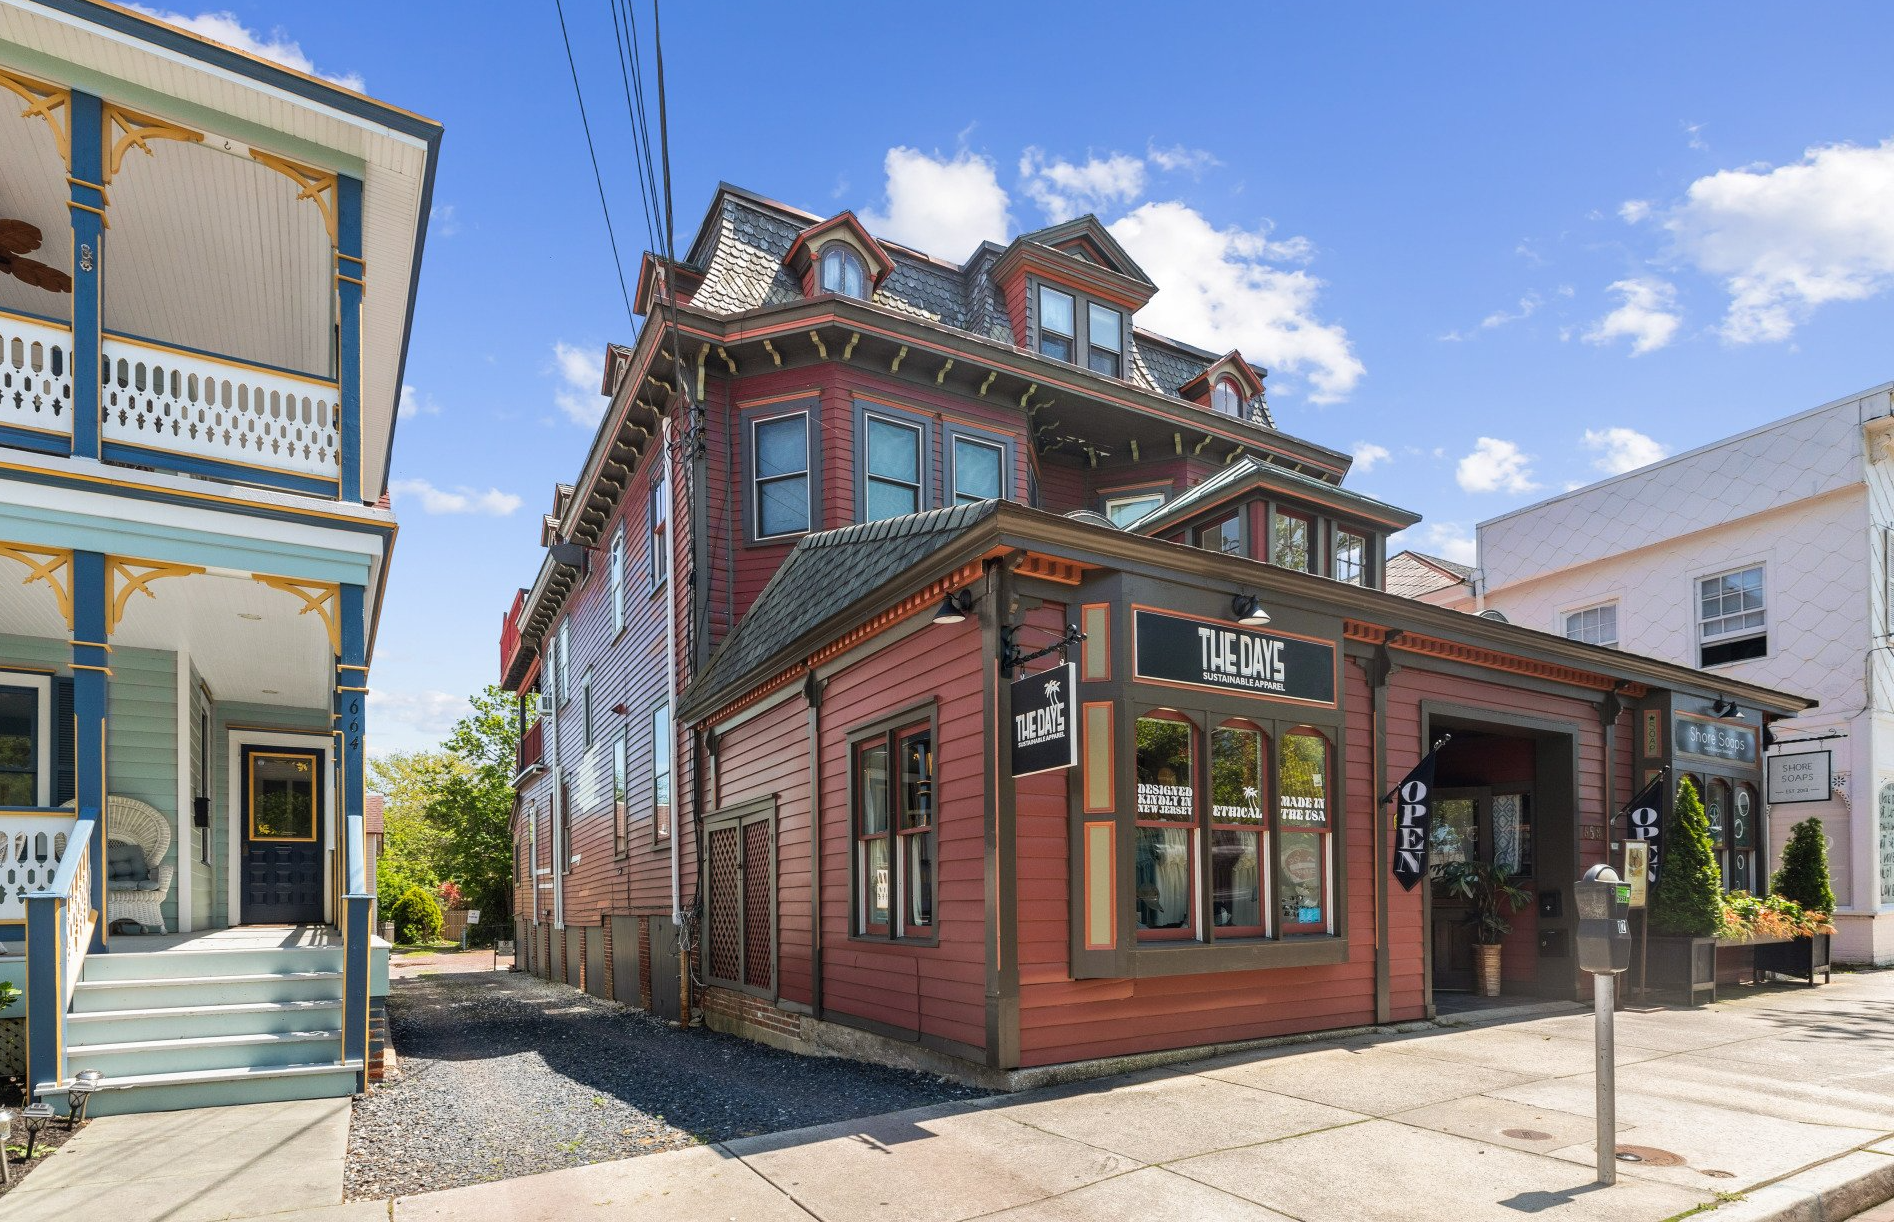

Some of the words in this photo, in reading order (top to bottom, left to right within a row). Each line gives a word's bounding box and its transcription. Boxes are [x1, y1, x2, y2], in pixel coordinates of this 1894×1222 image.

[1198, 627, 1237, 674] THE
[1240, 634, 1285, 682] DAYS
[1203, 672, 1253, 686] SUSTAINABLE
[1254, 680, 1285, 691] APPAREL
[349, 698, 359, 750] 664
[1015, 711, 1036, 741] THE
[1037, 703, 1064, 736] DAYS
[1018, 737, 1045, 748] SUSTAINABLE
[1045, 731, 1065, 741] APPAREL
[1690, 726, 1716, 745] Shore
[1718, 732, 1745, 752] Soaps
[1782, 762, 1813, 773] SHORE
[1781, 774, 1814, 783] SOAPS
[1137, 783, 1193, 796] DESIGNED
[1137, 794, 1179, 806] KINDLY
[1181, 796, 1193, 807] IN
[1280, 795, 1313, 809] MADE
[1314, 798, 1325, 809] IN
[1137, 804, 1159, 814] NEW
[1159, 804, 1193, 815] JERSEY
[1212, 805, 1263, 819] ETHICAL
[1281, 808, 1304, 821] THE
[1304, 810, 1326, 822] USA
[1395, 780, 1427, 874] OPEN
